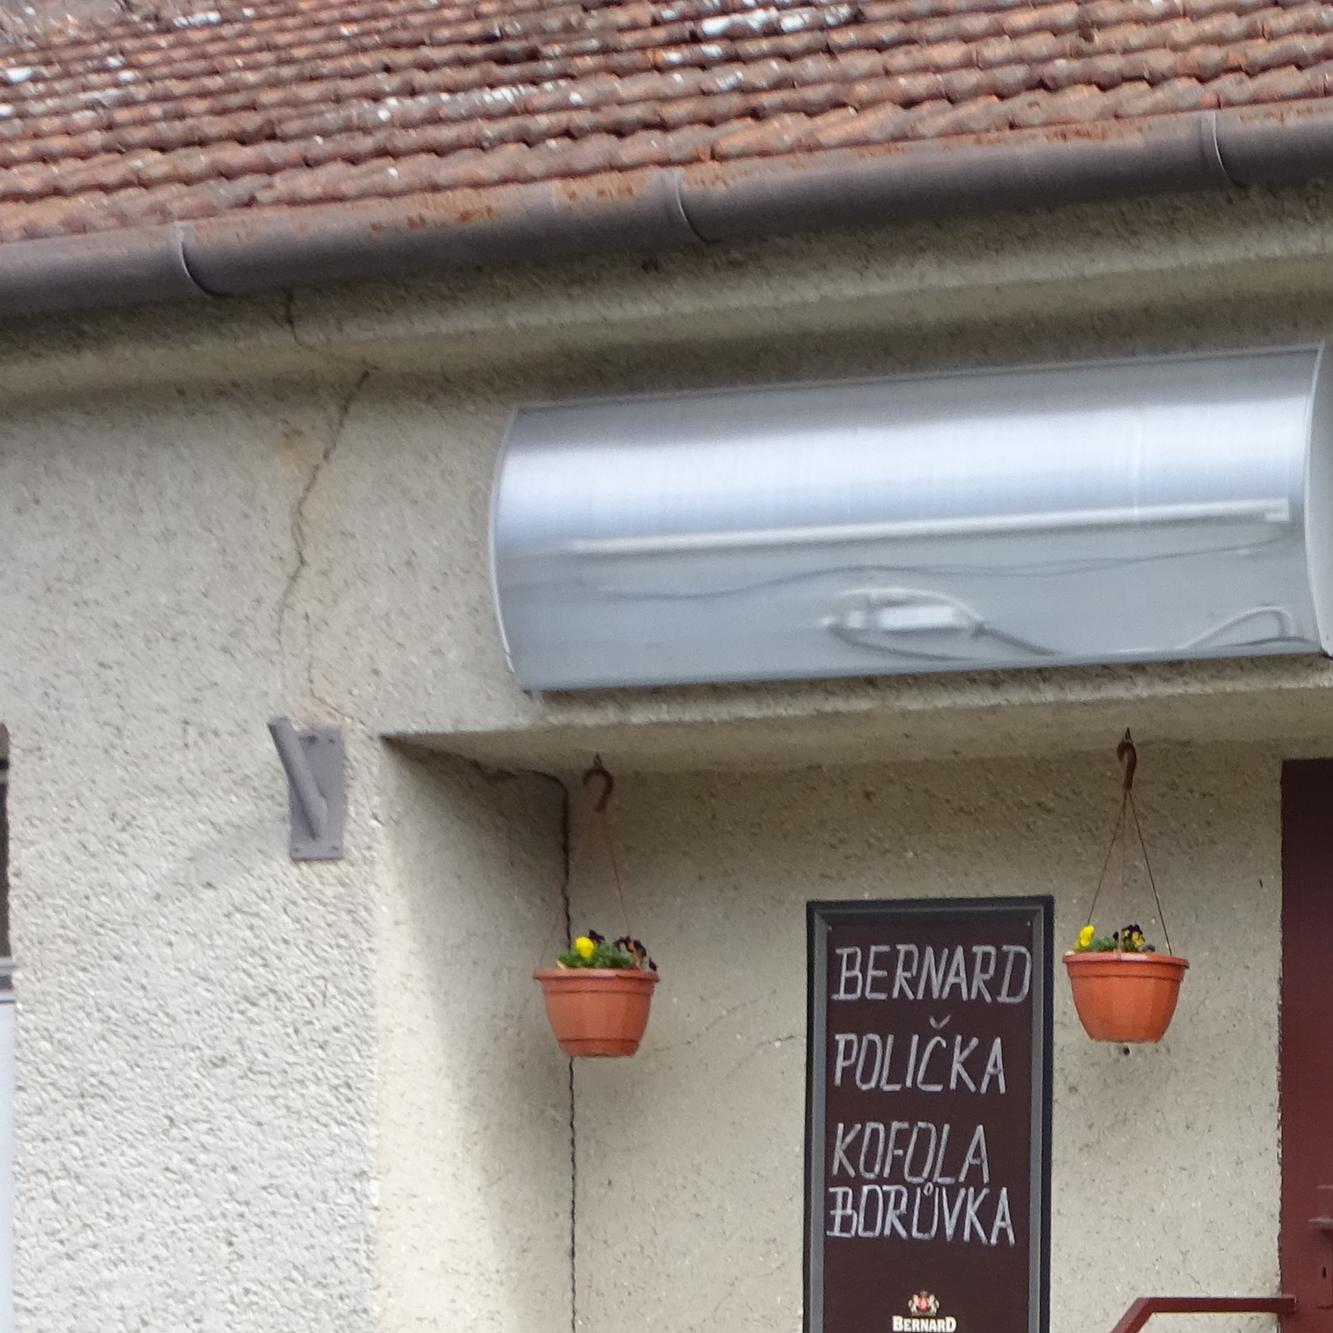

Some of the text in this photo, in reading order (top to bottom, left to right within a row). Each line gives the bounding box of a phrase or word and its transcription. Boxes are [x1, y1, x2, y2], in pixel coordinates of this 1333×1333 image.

[831, 944, 1032, 1003] BERNARD
[833, 1014, 1006, 1094] POLIČKA
[831, 1121, 990, 1185] KOFOLA
[827, 1181, 1016, 1246] BORŮVKA
[892, 1316, 957, 1333] BERNARD
